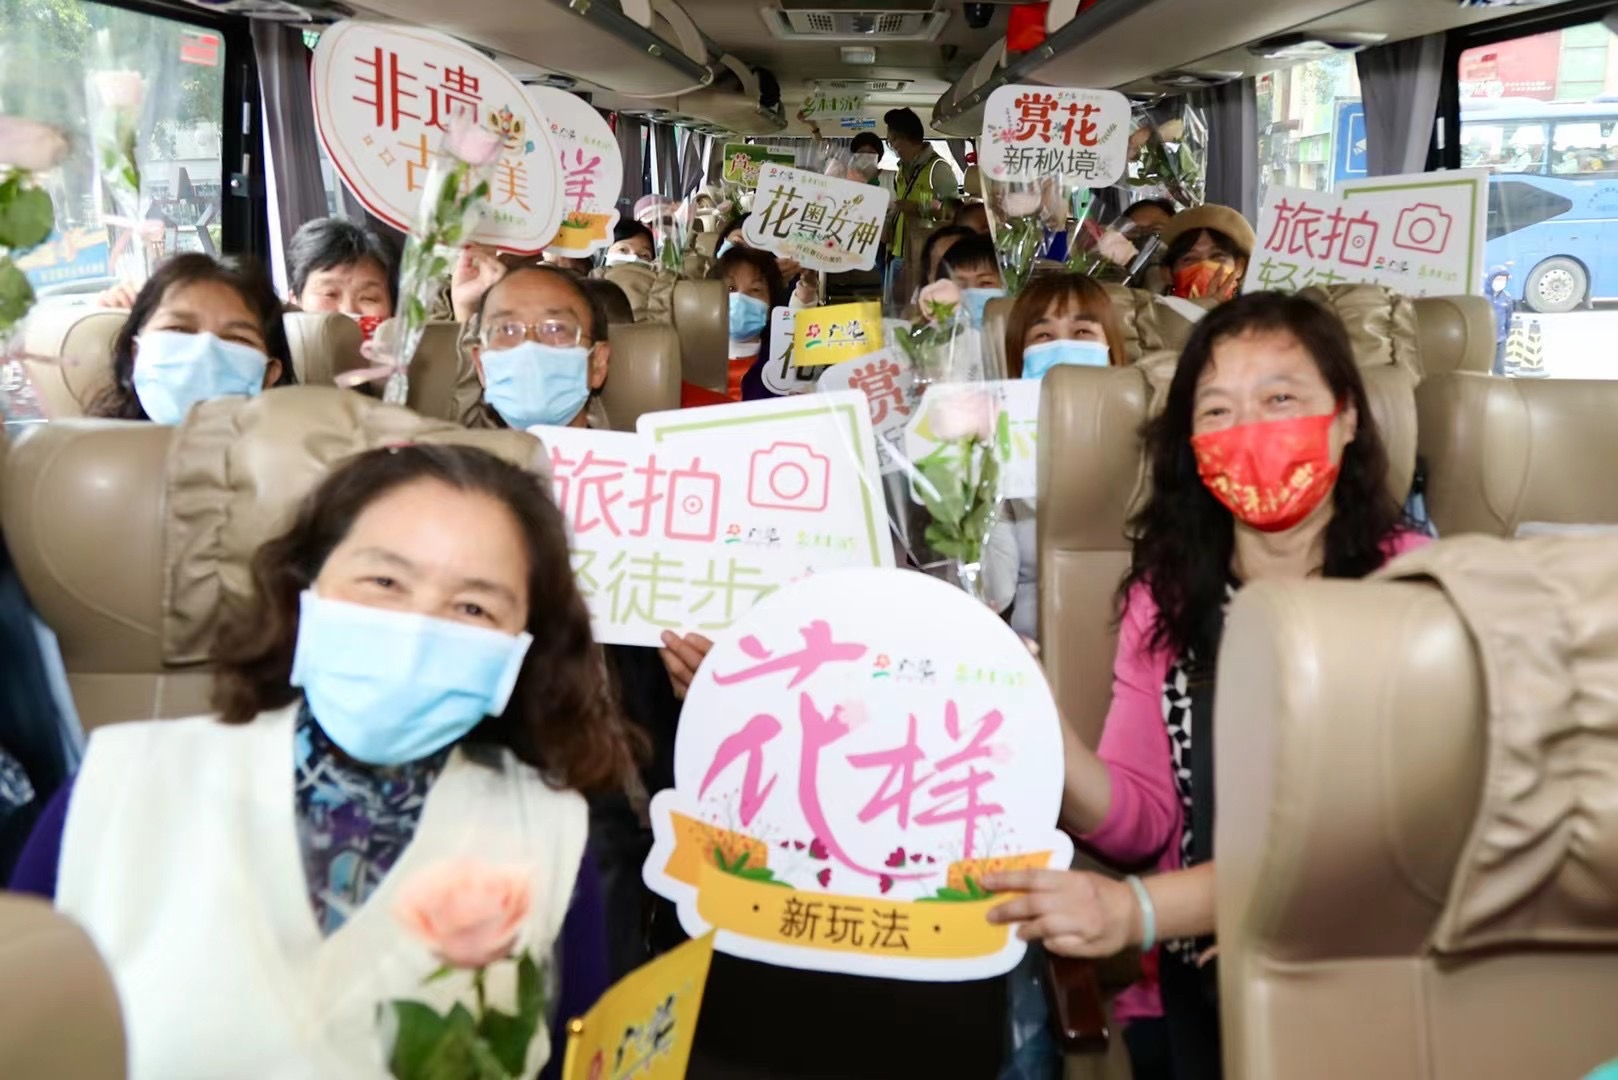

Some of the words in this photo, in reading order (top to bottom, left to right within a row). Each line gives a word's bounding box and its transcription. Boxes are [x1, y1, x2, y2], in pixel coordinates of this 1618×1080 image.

[352, 46, 483, 131] 非遗
[1014, 92, 1101, 147] 赏花
[398, 133, 531, 213] 古美
[1003, 145, 1098, 180] 新秘境
[758, 184, 880, 254] 花粤女神
[1264, 198, 1379, 268] 旅拍
[548, 446, 721, 543] 旅拍
[698, 618, 1006, 882] 花样
[778, 896, 911, 952] 新玩法
